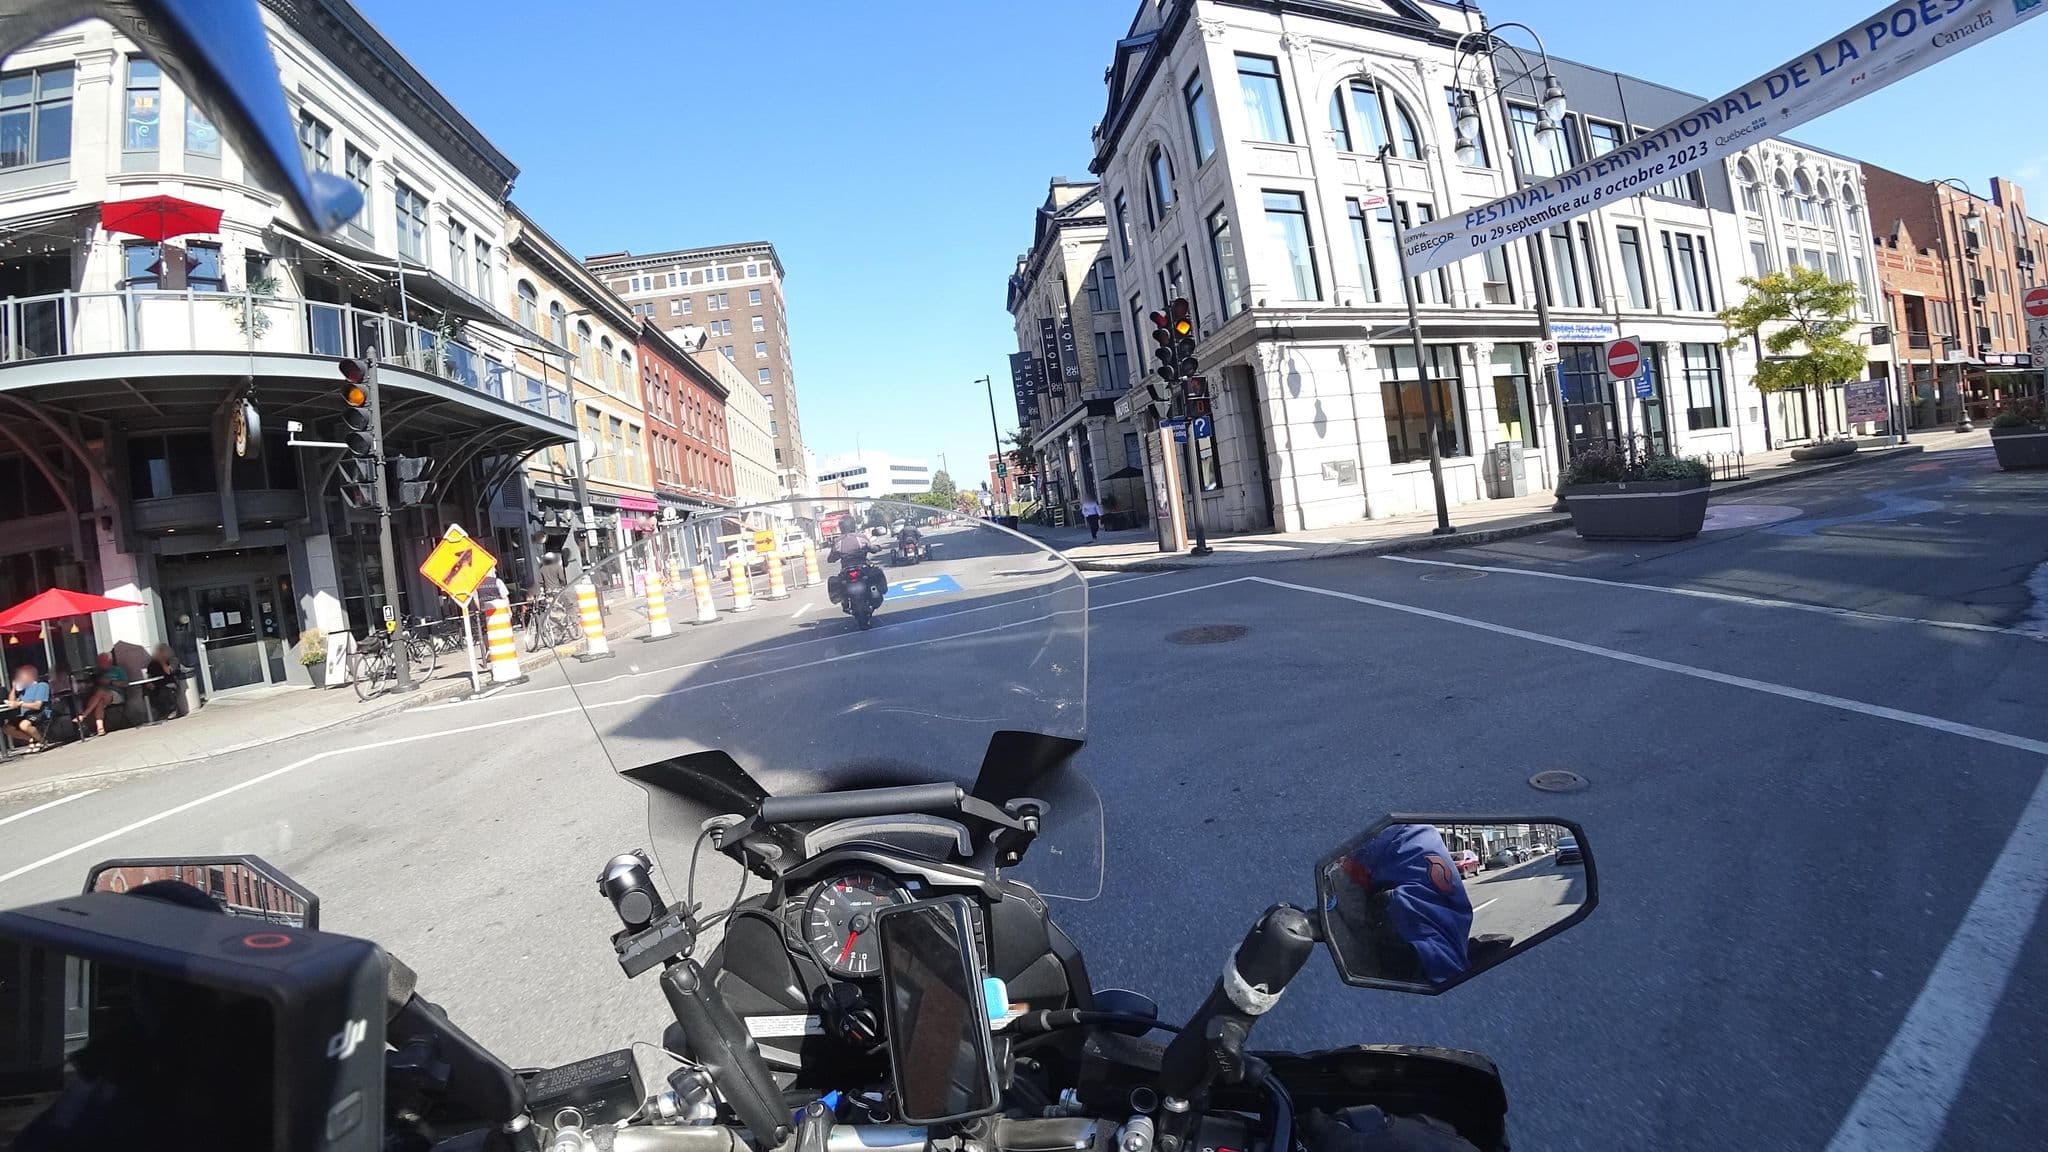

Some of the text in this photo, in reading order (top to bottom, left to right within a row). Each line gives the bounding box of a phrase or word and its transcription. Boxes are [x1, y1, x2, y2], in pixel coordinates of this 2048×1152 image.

[1931, 12, 1994, 48] Canada
[1465, 185, 1554, 229] FESTIVAL
[1558, 91, 1762, 194] INTERNATIONAL
[1764, 62, 1810, 99] DE
[1813, 39, 1860, 76] LA
[1715, 124, 1751, 146] Québec
[1471, 140, 1708, 247] Du 29 septembre au 8 octobre 2023
[1405, 232, 1454, 257] UÉBECOR
[1045, 324, 1058, 370] HÔTEL
